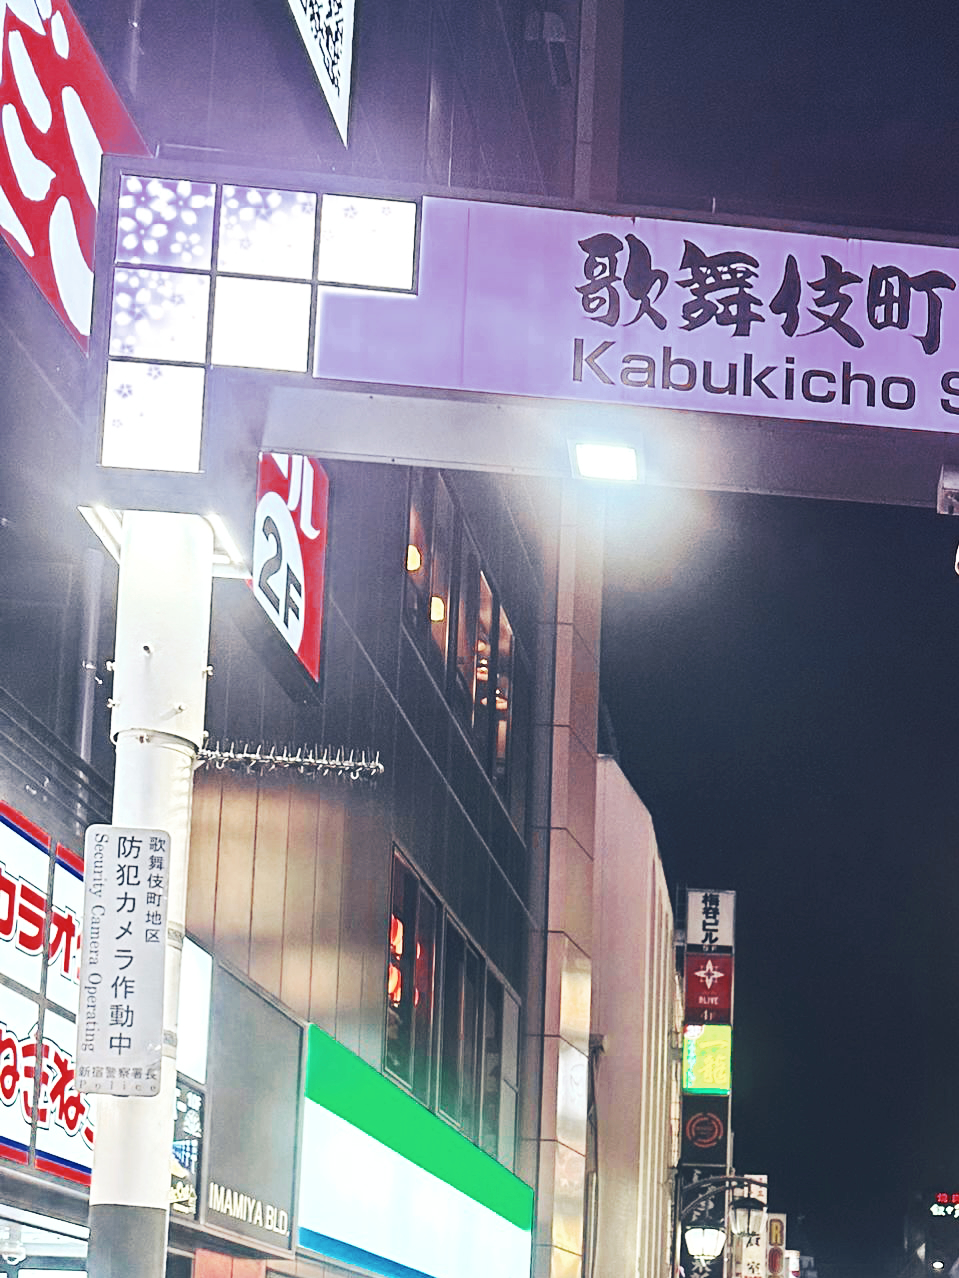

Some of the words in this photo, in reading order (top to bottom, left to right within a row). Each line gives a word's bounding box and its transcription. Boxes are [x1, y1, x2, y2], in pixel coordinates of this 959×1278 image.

[574, 233, 956, 355] 歌舞伎町
[572, 337, 917, 411] Kabukicho
[258, 515, 302, 629] 2F
[89, 833, 109, 897] Security
[145, 836, 166, 943] 歌舞伎町地区
[89, 905, 106, 965] Camera
[109, 835, 143, 1056] 防犯カメラ作動中
[81, 972, 103, 1052] Operating
[79, 1065, 158, 1081] 新宿警察署長
[209, 1182, 263, 1227] IMAMIYA
[265, 1205, 290, 1237] BLD.
